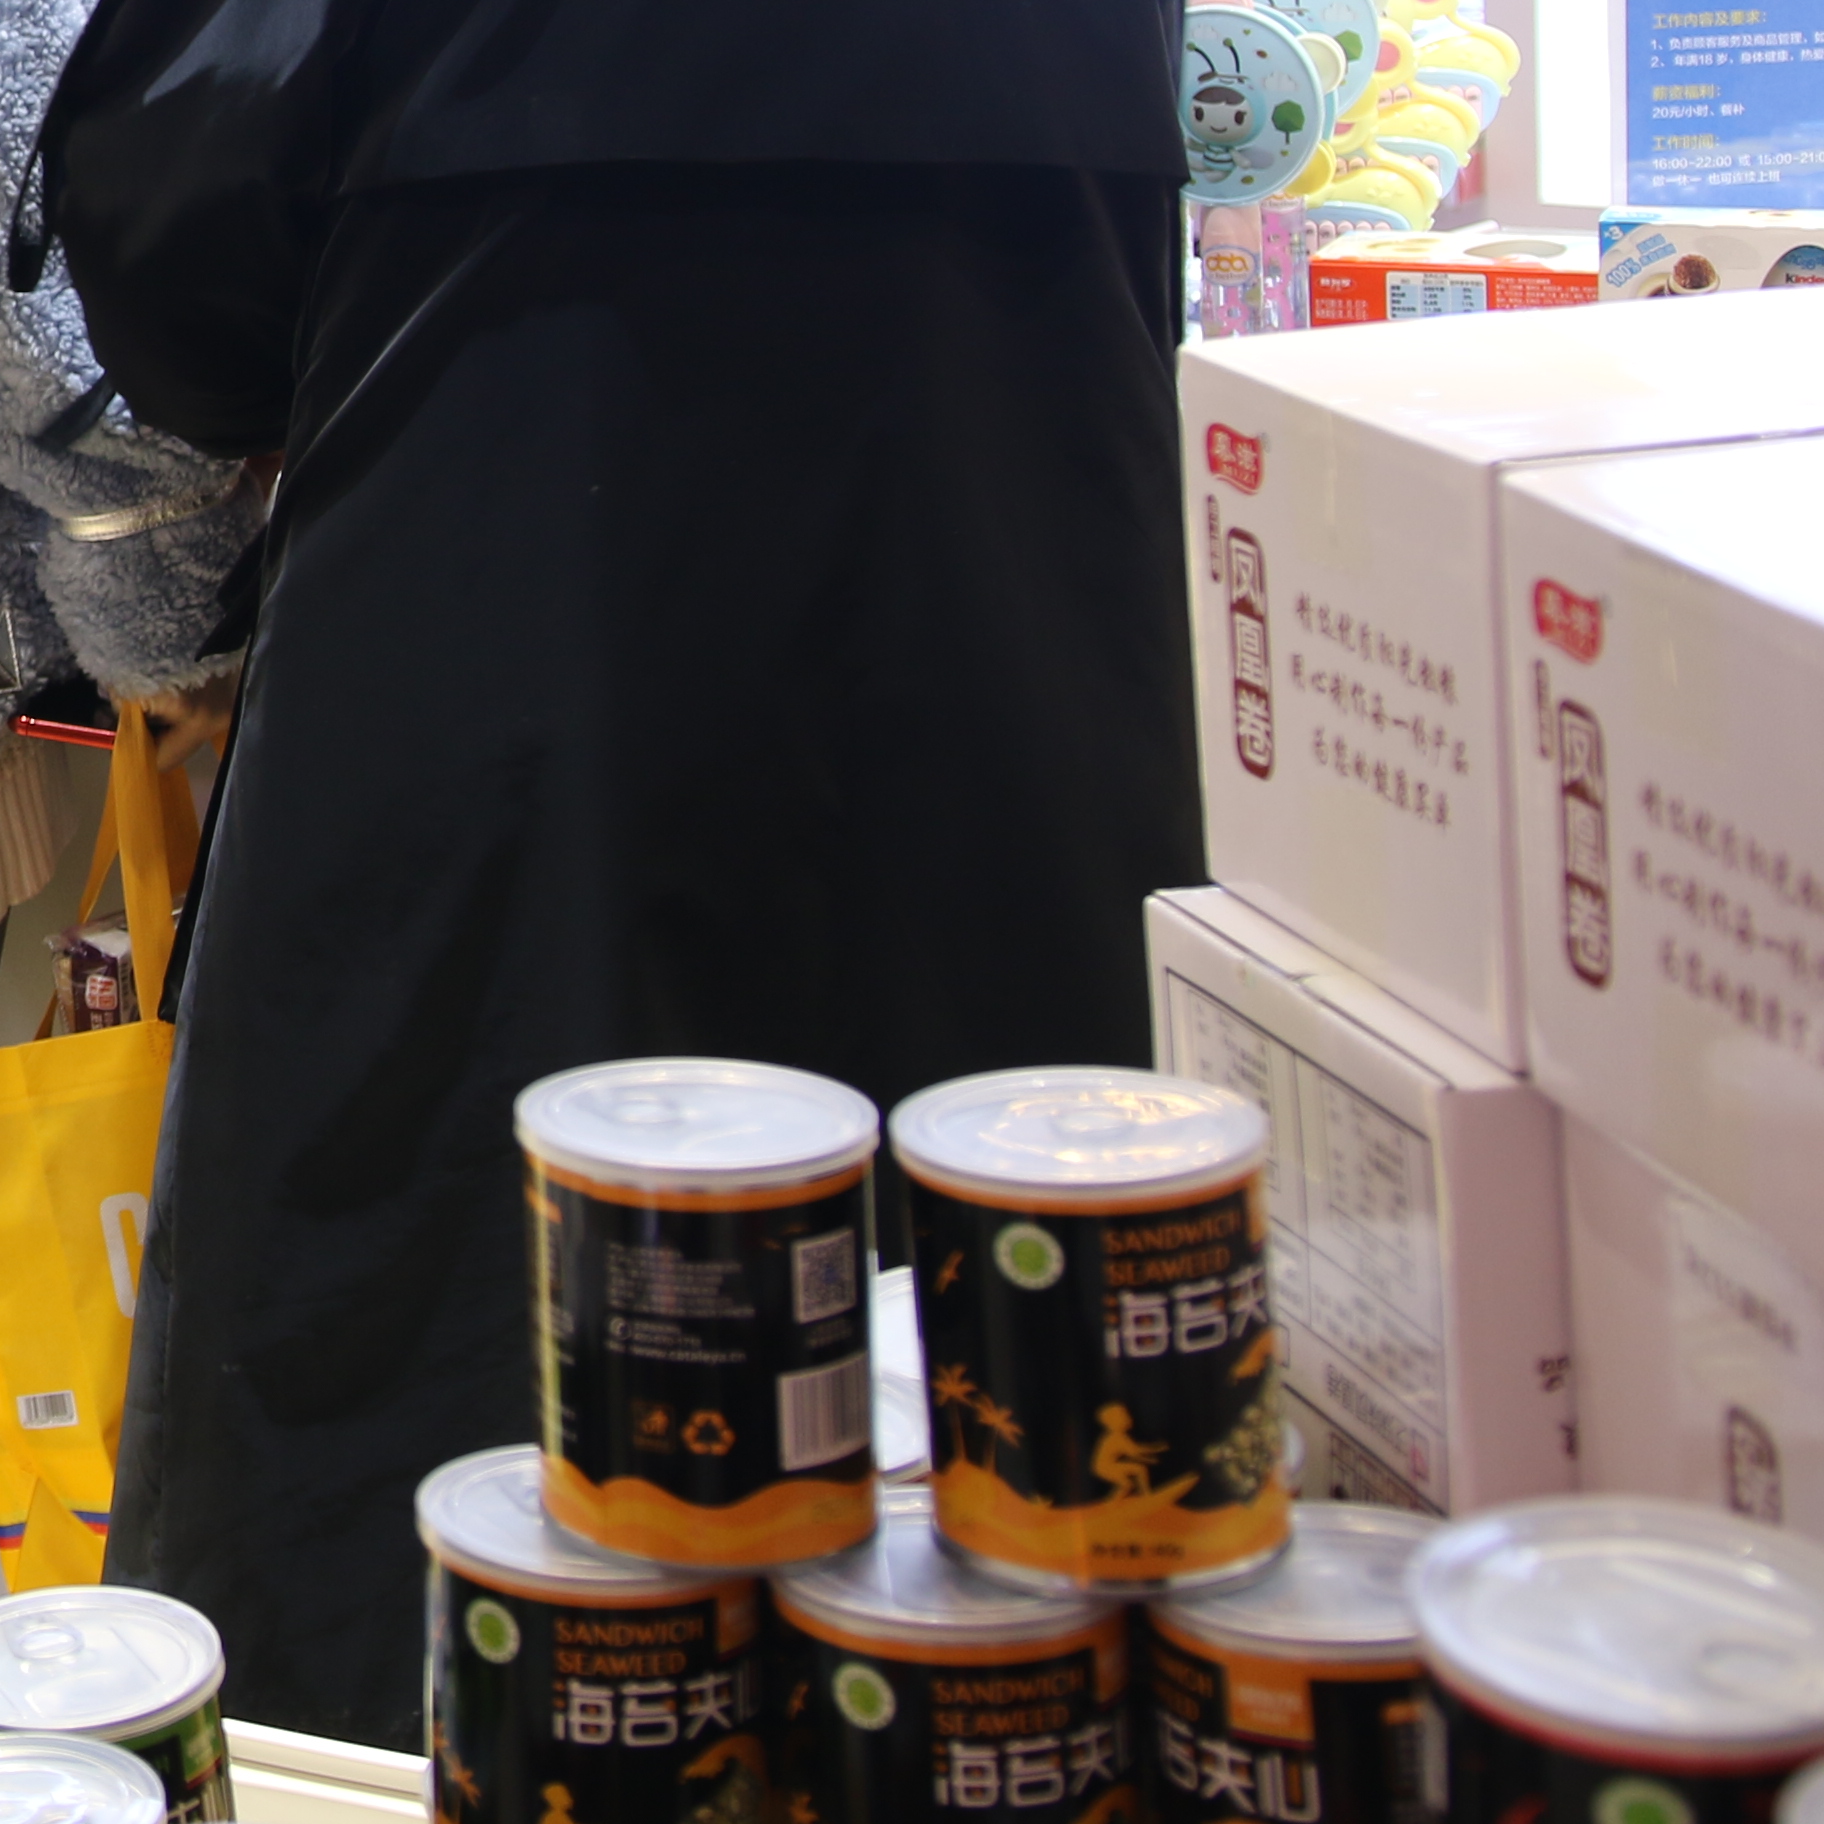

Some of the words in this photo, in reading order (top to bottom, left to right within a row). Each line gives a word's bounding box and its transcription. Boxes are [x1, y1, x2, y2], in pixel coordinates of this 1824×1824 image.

[1106, 1210, 1243, 1255] SANDWICH
[1106, 1246, 1233, 1288] SEAWEED
[555, 1617, 705, 1647] SANDWICH
[556, 1649, 688, 1677] SEAWEED
[932, 1666, 1085, 1705] SANDWICH
[933, 1704, 1070, 1736] SEAWEED
